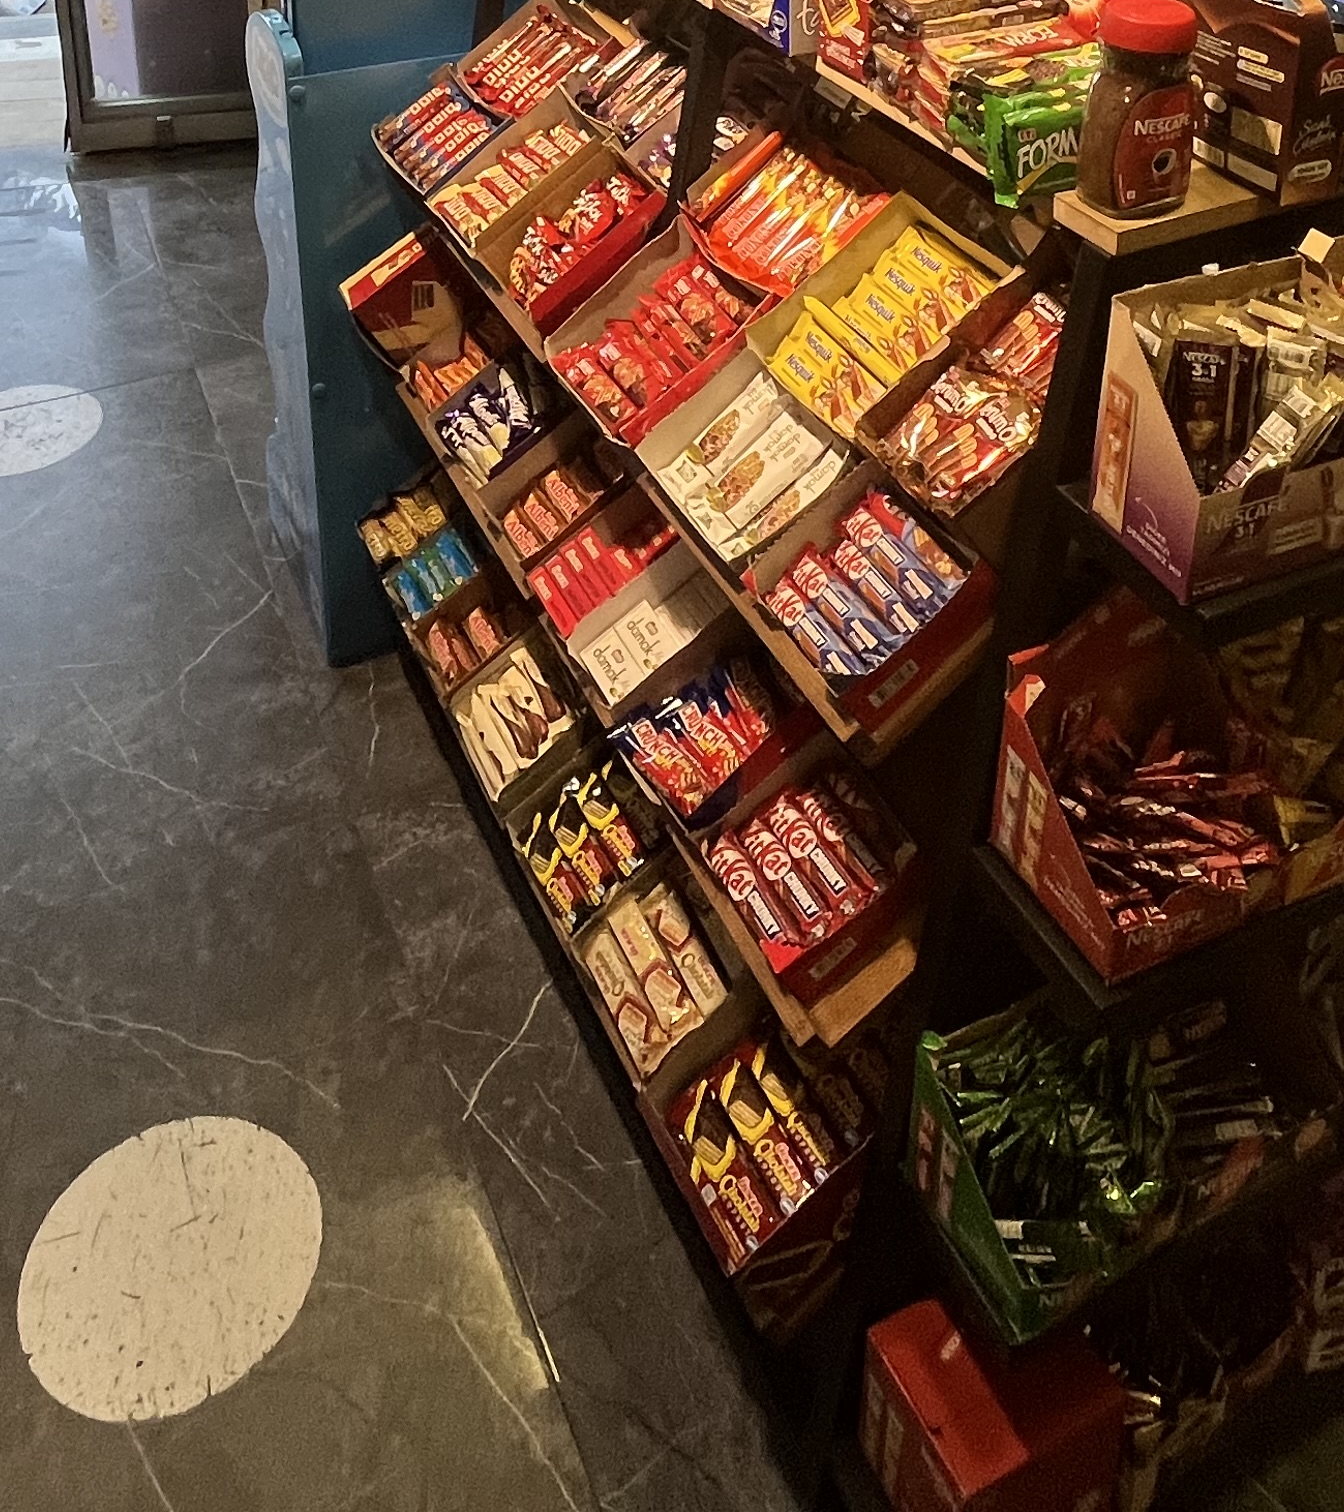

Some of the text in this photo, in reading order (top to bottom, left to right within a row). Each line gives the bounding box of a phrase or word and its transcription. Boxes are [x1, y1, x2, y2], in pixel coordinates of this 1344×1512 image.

[885, 267, 917, 297] Nesquik
[911, 245, 942, 276] Nesquik
[865, 293, 896, 323] Nesquik
[625, 614, 656, 658] damak
[591, 637, 620, 687] damak
[748, 889, 780, 939] CHUNKY
[782, 871, 819, 920] CHUNKY
